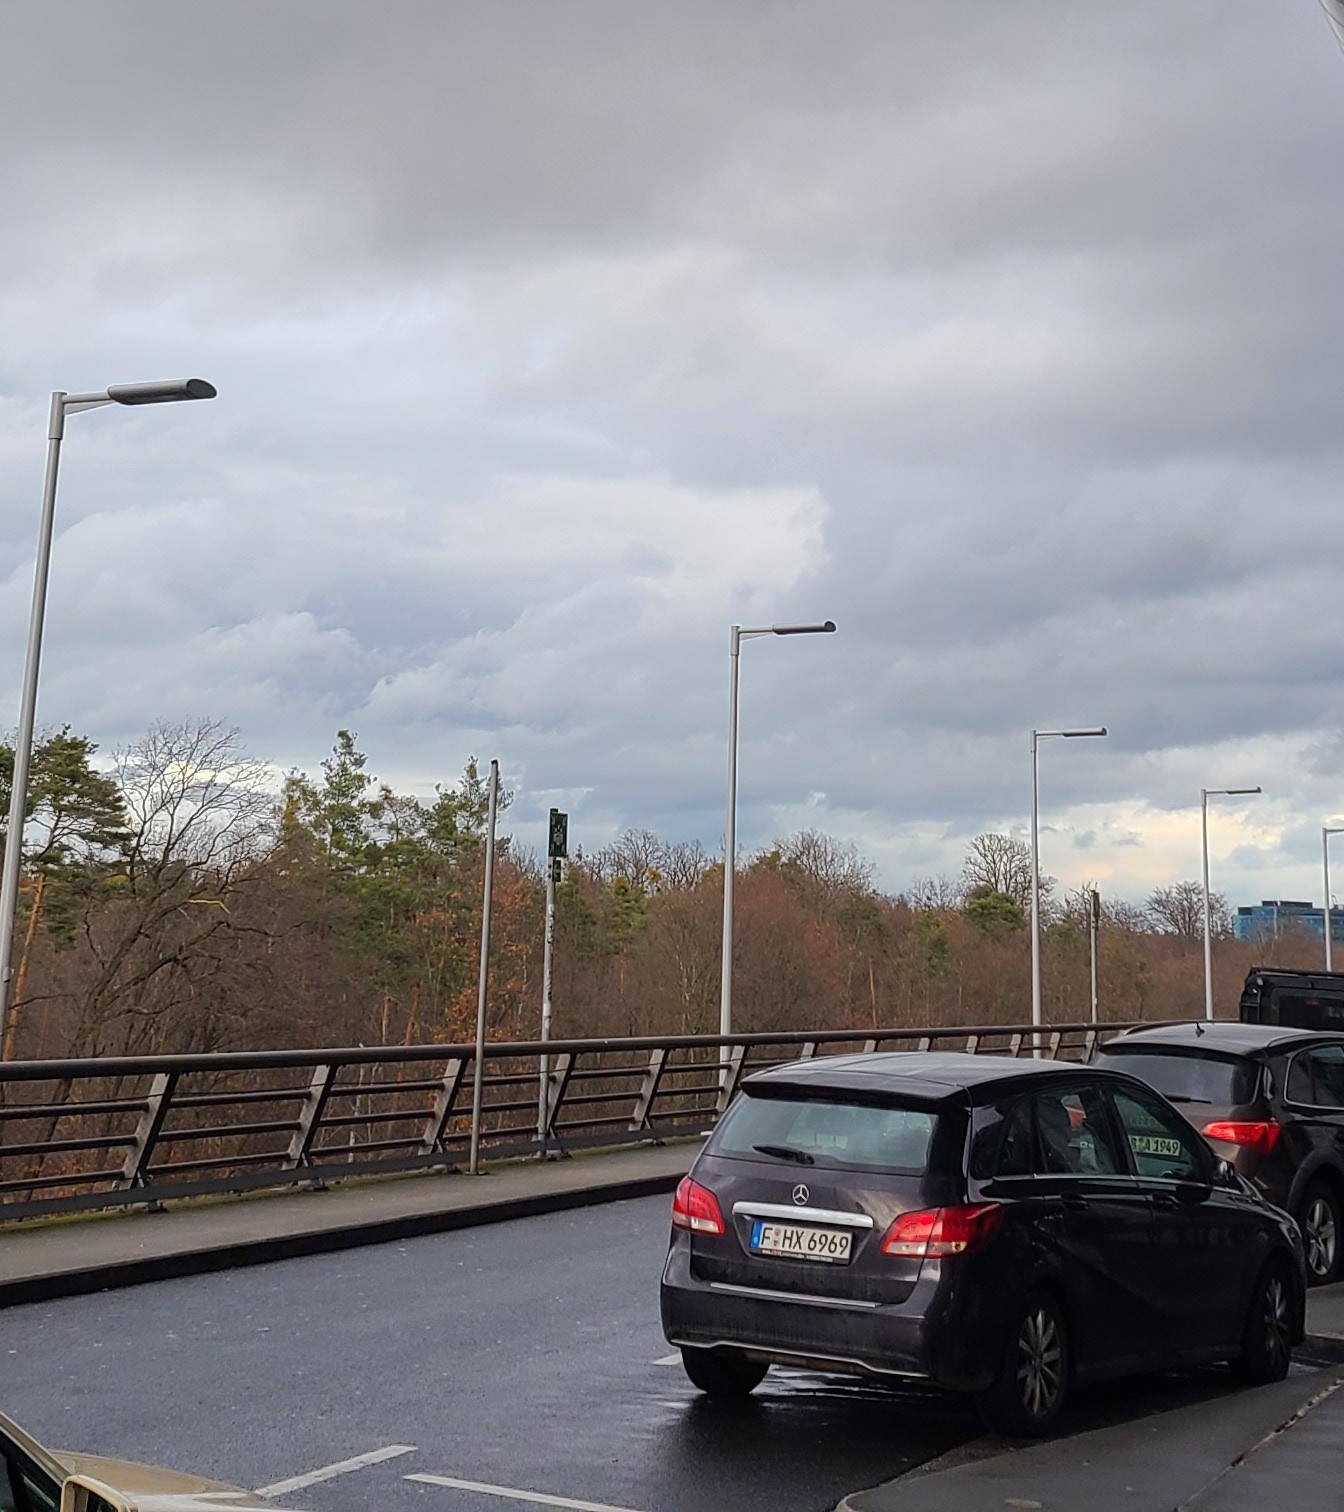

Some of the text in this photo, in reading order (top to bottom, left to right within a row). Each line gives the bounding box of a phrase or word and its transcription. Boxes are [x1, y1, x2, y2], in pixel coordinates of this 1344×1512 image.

[1152, 1139, 1179, 1154] 1949
[760, 1227, 773, 1245] F
[782, 1229, 805, 1250] HX
[807, 1233, 850, 1255] 6969
